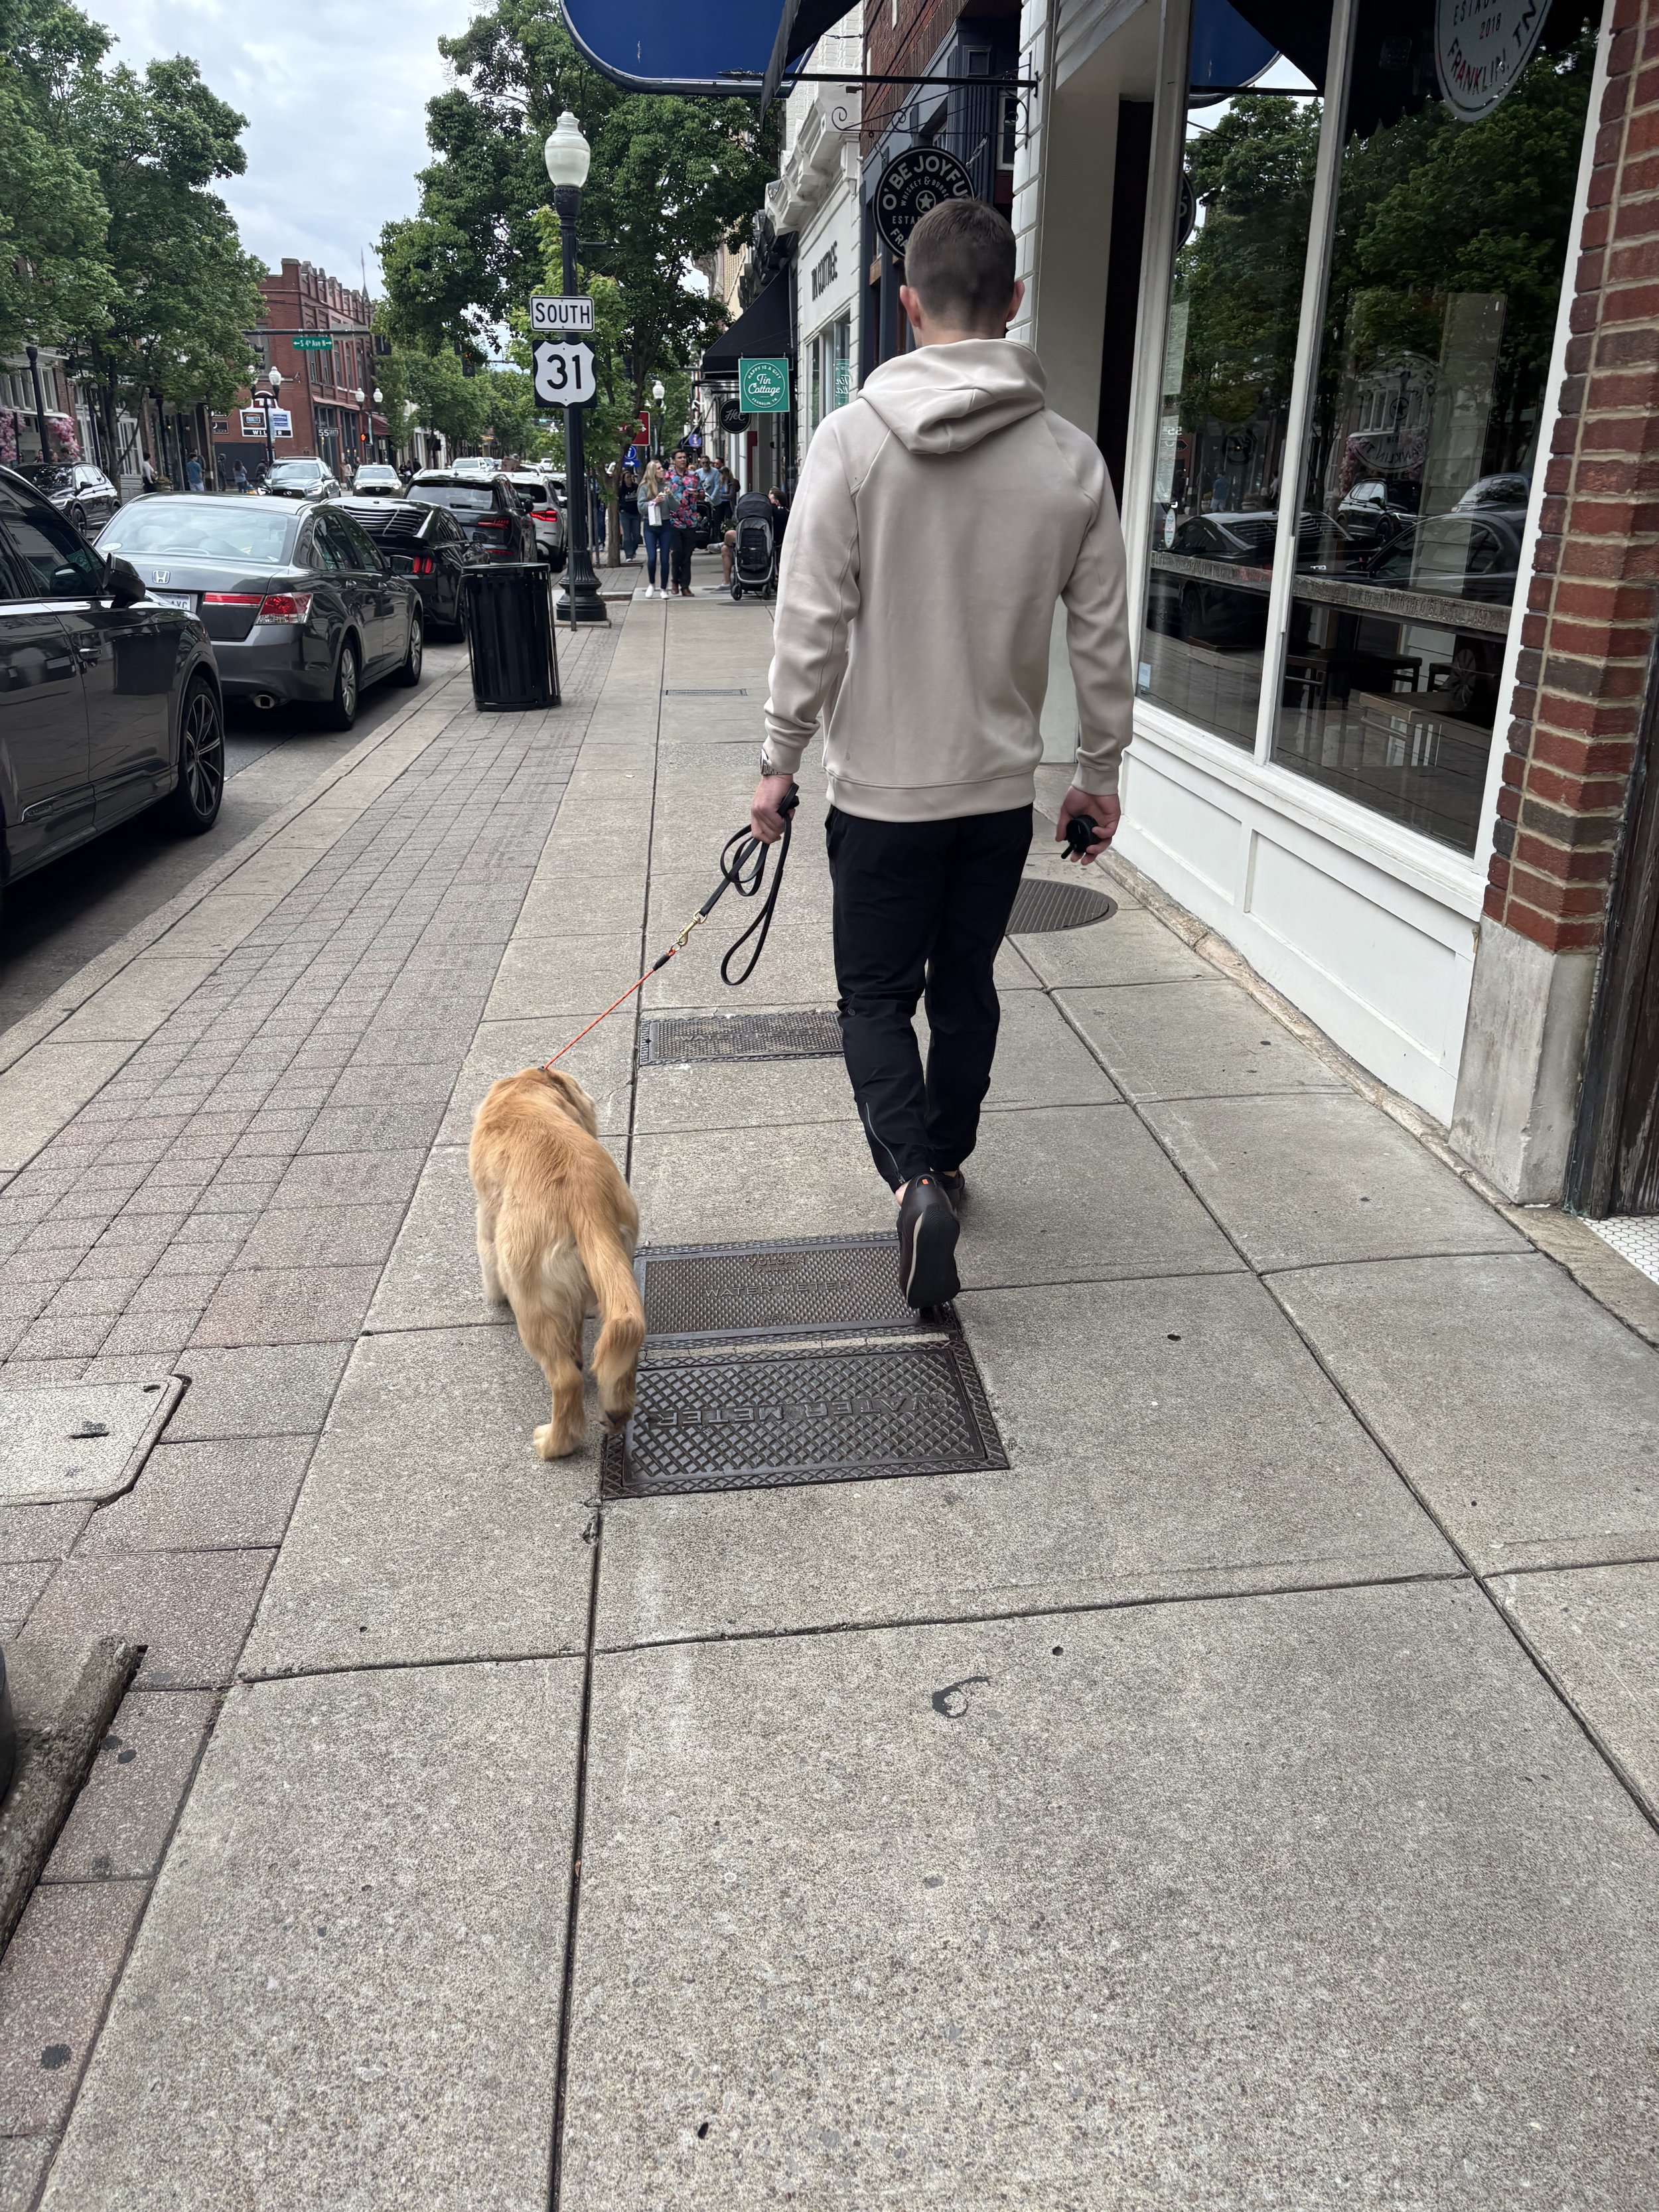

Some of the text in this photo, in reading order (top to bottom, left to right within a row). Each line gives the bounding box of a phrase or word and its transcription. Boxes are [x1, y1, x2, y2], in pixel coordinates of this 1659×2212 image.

[1453, 0, 1496, 26] ESTA
[1479, 12, 1502, 40] 2018
[1512, 0, 1536, 49] TN
[888, 162, 912, 190] BE
[913, 155, 969, 197] JOYFU
[900, 176, 950, 206] WHISKEY & BURGE
[890, 228, 909, 250] FRA
[535, 302, 590, 324] SOUTH
[547, 354, 582, 390] 31
[748, 366, 760, 379] HAPPY
[772, 369, 782, 379] GIFT
[757, 374, 771, 384] Tin
[748, 382, 780, 396] Cottage
[679, 1029, 819, 1042] WATER METER
[747, 1257, 805, 1267] VULCAN
[705, 1280, 851, 1297] WATER METER
